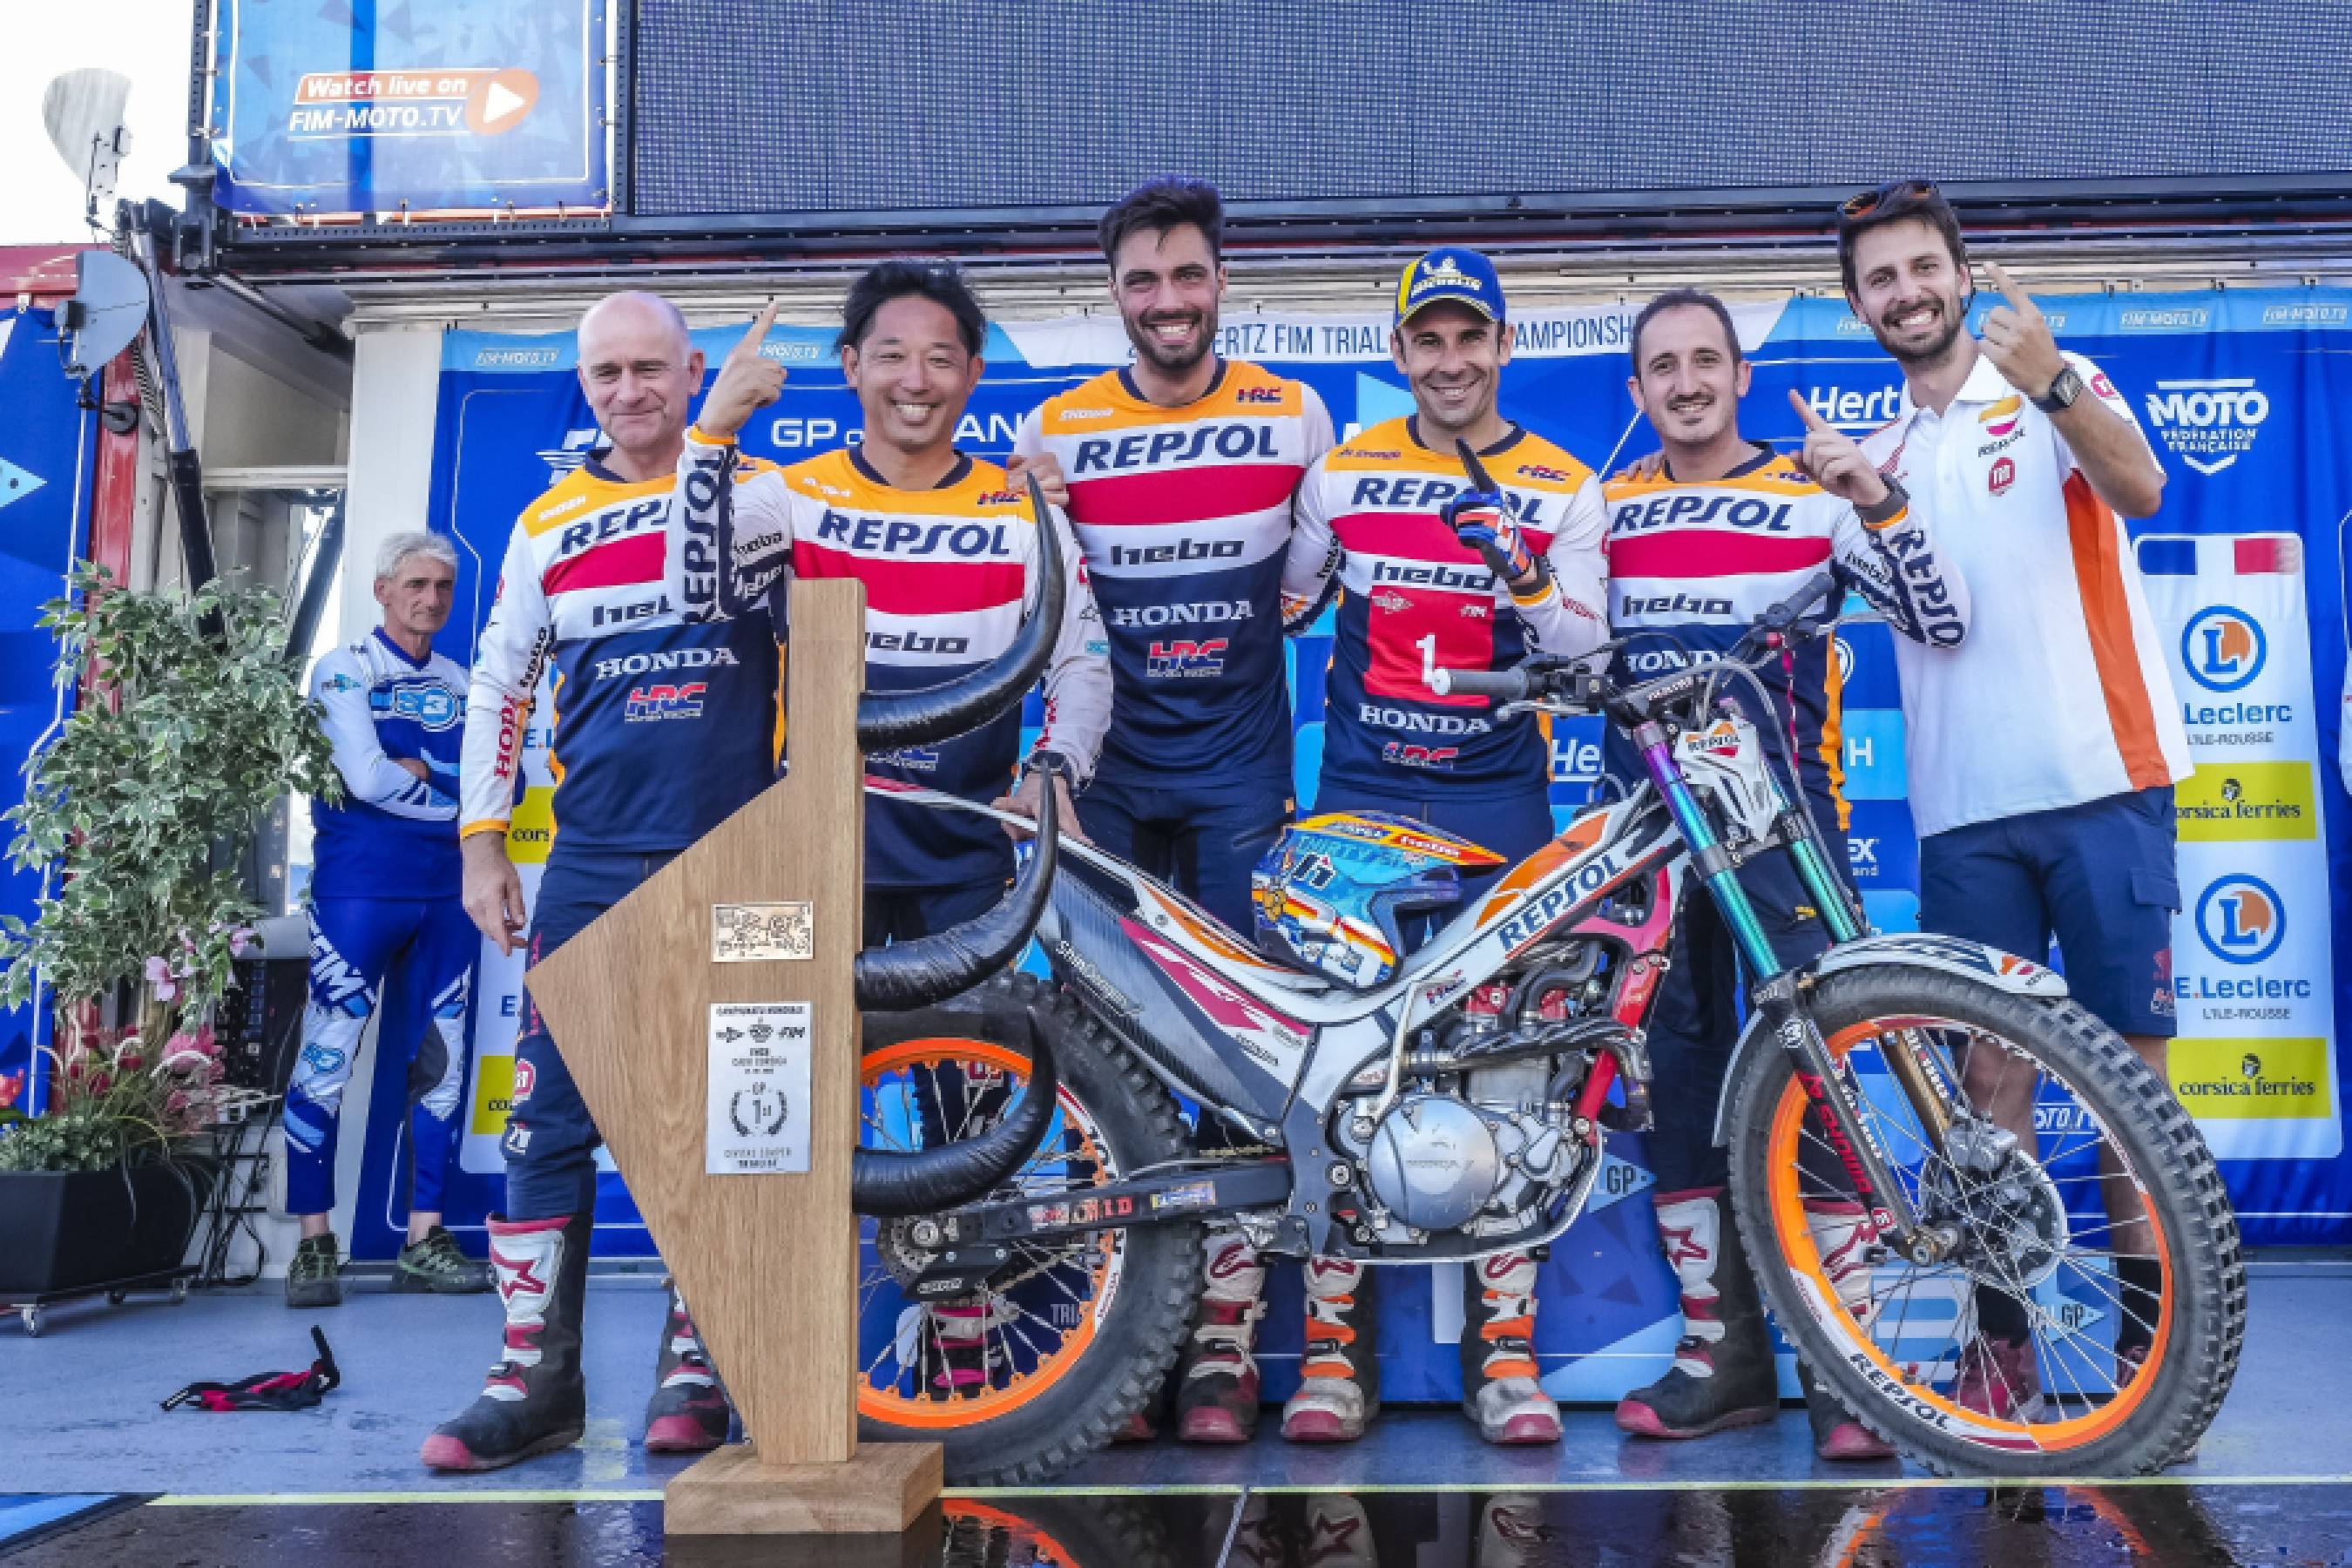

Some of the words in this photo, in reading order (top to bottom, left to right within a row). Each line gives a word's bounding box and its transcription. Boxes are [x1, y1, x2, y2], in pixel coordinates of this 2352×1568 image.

[308, 79, 379, 98] Watch
[389, 76, 430, 94] live
[436, 78, 467, 93] on
[289, 105, 463, 132] FIM-MOTO.TV
[1274, 324, 1313, 354] FIM
[1321, 326, 1389, 355] TRIAL
[1514, 314, 1632, 351] AMPIONSH
[1808, 383, 1902, 421] Hert
[2146, 390, 2269, 427] MOTO
[771, 418, 837, 447] GP
[1074, 424, 1279, 473] REPSOL
[1611, 496, 1794, 534] REPSOL
[817, 508, 1011, 557] REPSOL
[1110, 537, 1245, 565] hebo
[1373, 561, 1496, 592] hebo
[1111, 599, 1254, 627] HONDA
[1622, 591, 1734, 618] hebo
[595, 647, 740, 682] HONDA
[1359, 703, 1492, 734] HONDA
[2184, 702, 2293, 725] Leclerc
[2235, 800, 2301, 818] ferries
[1497, 852, 1624, 953] REPSOL
[2175, 976, 2311, 999] E.Leclerc
[2179, 1076, 2251, 1096] corsica
[2254, 1076, 2315, 1096] ferries
[1606, 1165, 1639, 1195] GP
[1849, 1351, 1950, 1430] REPSOL
